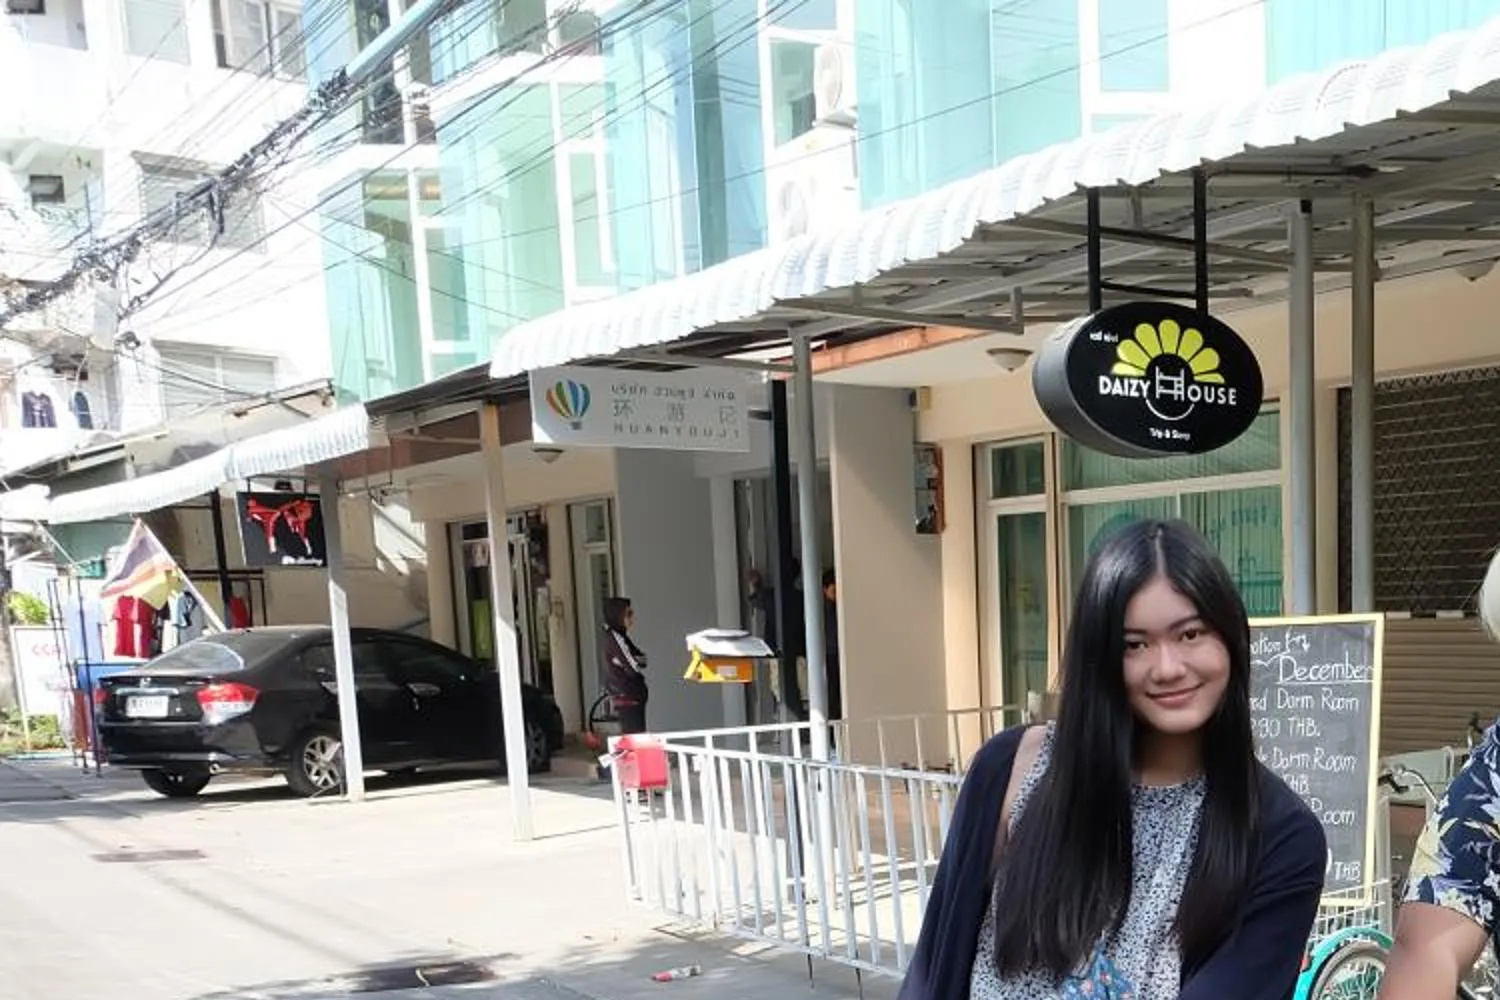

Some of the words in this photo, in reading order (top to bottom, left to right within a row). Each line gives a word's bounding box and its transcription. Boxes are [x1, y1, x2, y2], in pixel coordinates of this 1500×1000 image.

[1098, 375, 1150, 399] DAIZY
[1155, 364, 1238, 406] HOUSE
[1279, 649, 1375, 682] December
[1276, 687, 1316, 710] Dorm
[1320, 686, 1359, 712] Room
[1271, 746, 1311, 770] Dorm
[1313, 746, 1358, 774] Room
[1322, 810, 1356, 826] oom
